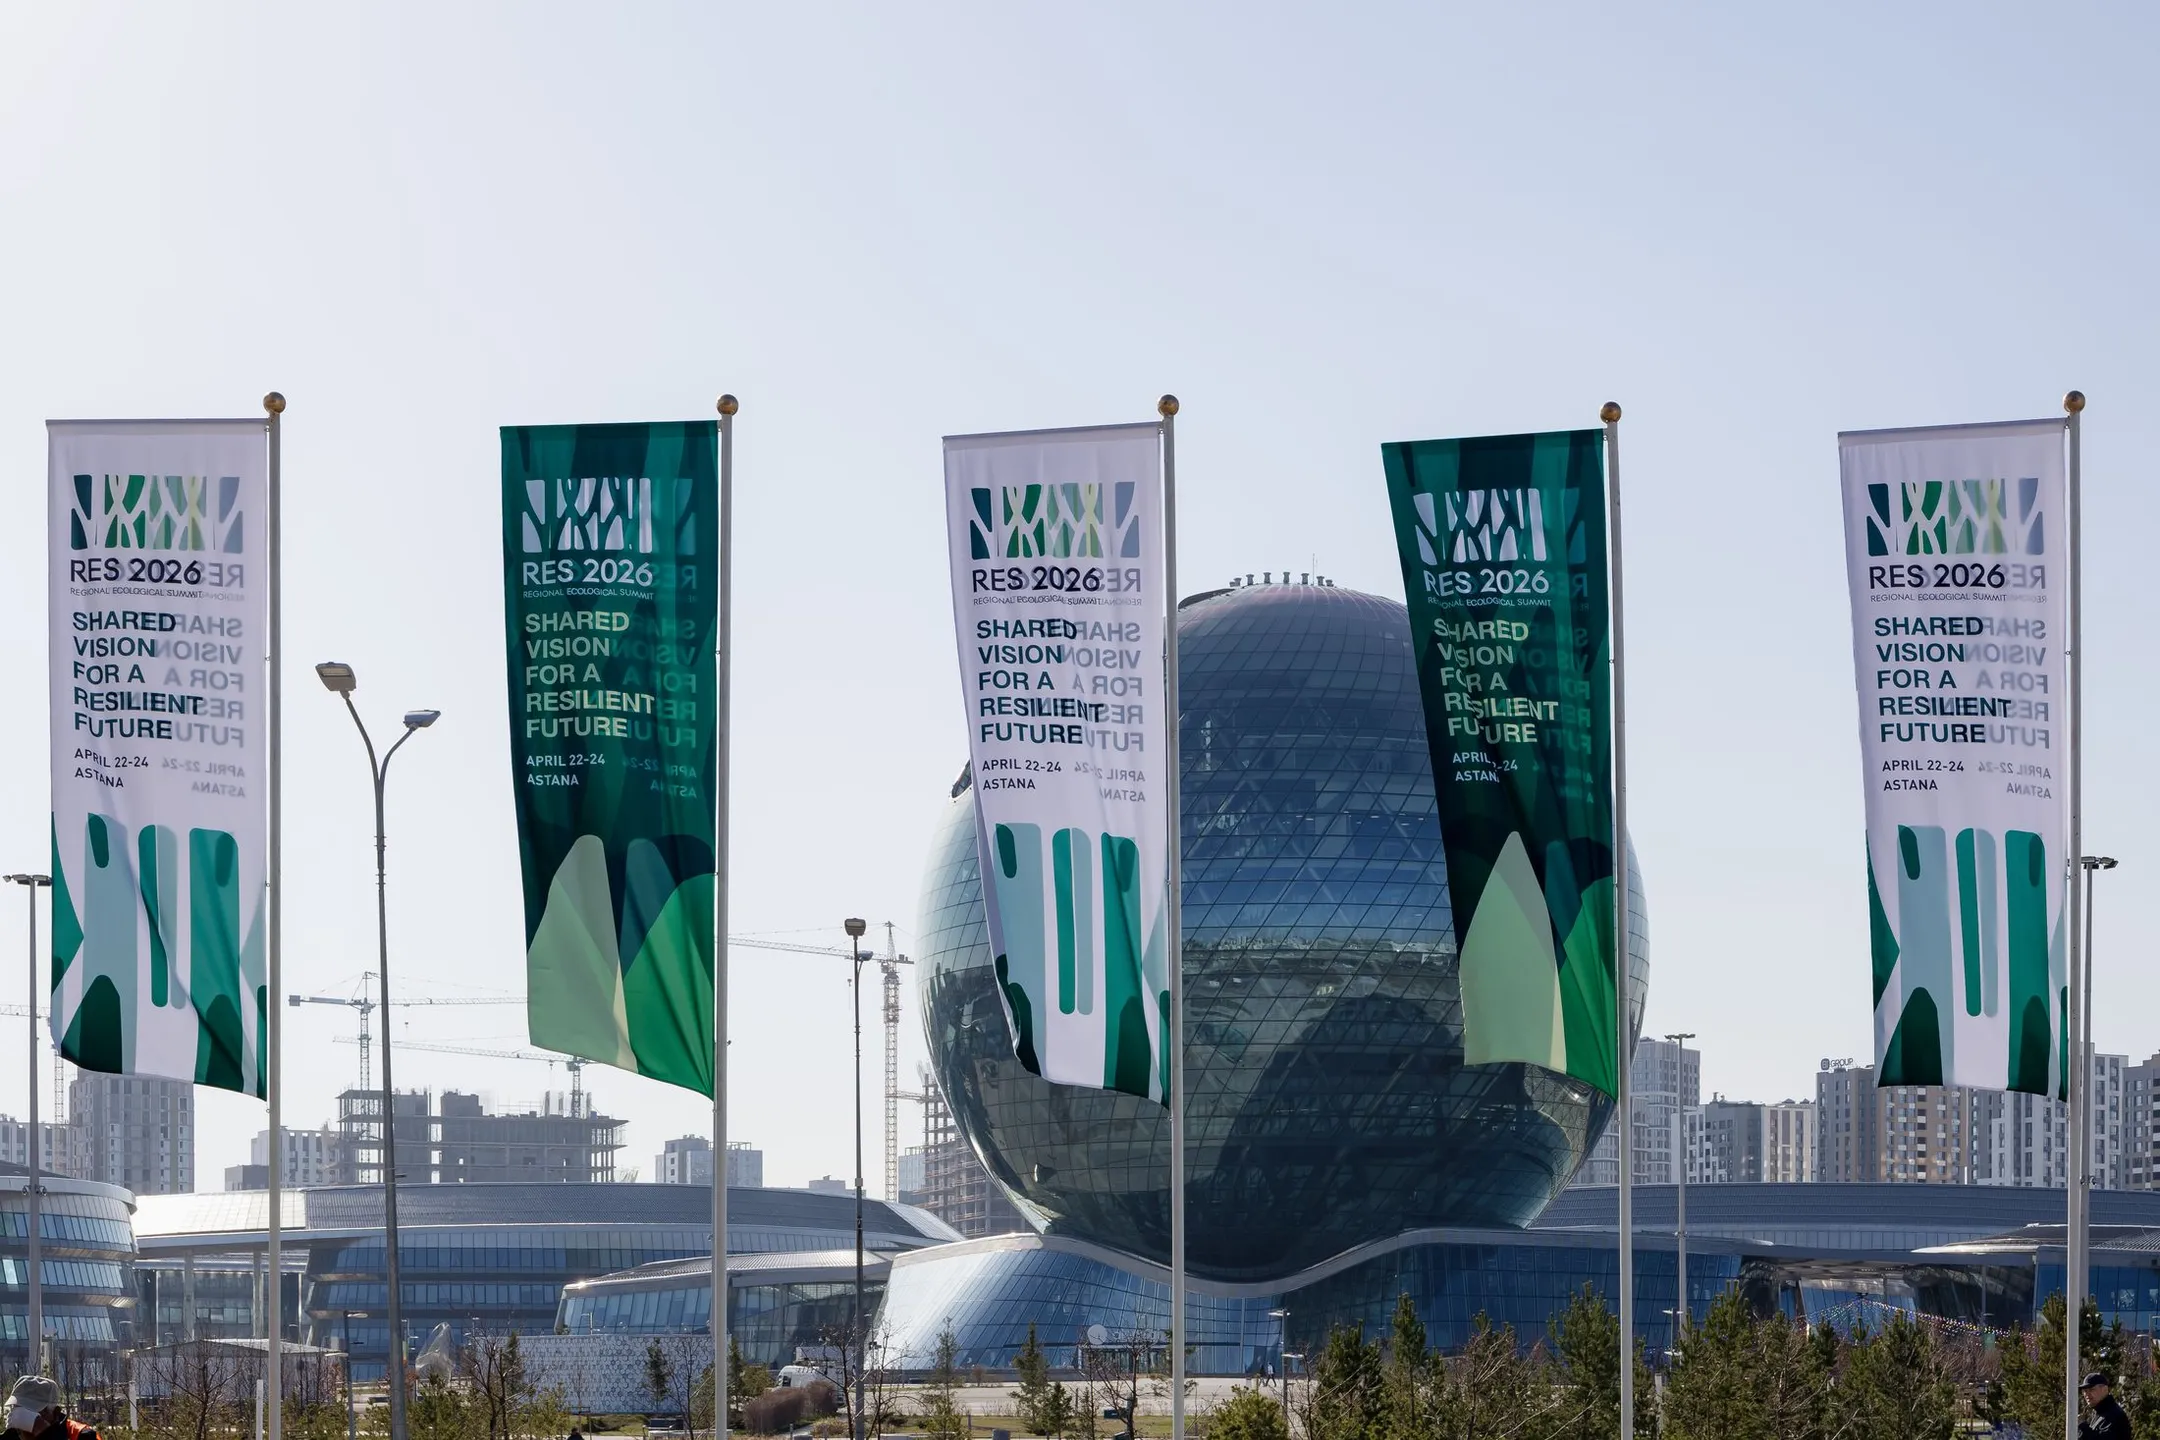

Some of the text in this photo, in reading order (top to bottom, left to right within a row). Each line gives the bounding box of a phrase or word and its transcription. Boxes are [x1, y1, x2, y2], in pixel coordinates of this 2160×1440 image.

[71, 558, 201, 585] RES 2026
[523, 558, 574, 586] RES
[582, 558, 653, 587] 2026
[972, 566, 1100, 593] RES 2026
[1869, 563, 2005, 589] RES 2026
[70, 587, 110, 597] REGIONAL
[112, 587, 164, 597] ECOLOGICAL
[167, 589, 202, 599] SUMMIT
[1423, 570, 1472, 597] RES
[1480, 568, 1549, 595] 2026
[523, 587, 654, 600] REGIONAL ECOLOGICAL SUMMIT
[973, 595, 1101, 606] REGIONAL ECOLOGICAL SUMMIT
[1466, 596, 1515, 607] ECOLOGICAL
[1517, 598, 1552, 607] SUMMIT
[1870, 593, 1915, 602] REGIONAL
[1917, 592, 1970, 602] ECOLOGICAL
[1972, 593, 2007, 602] SUMMIT
[73, 611, 176, 632] SHARED
[525, 611, 630, 633] SHARED
[976, 618, 1077, 639] SHARED
[1433, 618, 1529, 642] SHARED
[1874, 617, 1984, 637] SHARED
[74, 636, 155, 658] VISION
[526, 636, 610, 659] VISION
[978, 644, 1062, 665] VISION
[1876, 643, 1965, 663] VISION
[74, 661, 145, 685] FOR A
[525, 663, 601, 686] FOR A
[979, 670, 1055, 690] FOR A
[1489, 672, 1508, 691] A
[1877, 669, 1957, 689] FOR A
[74, 686, 203, 715] RESILIENT
[526, 689, 655, 714] RESILIENT
[980, 696, 1104, 723] RESILIENT
[1879, 696, 2012, 718] RESILIENT
[75, 712, 172, 740] FUTURE
[526, 716, 628, 738] FUTURE
[981, 722, 1083, 744] FUTURE
[1447, 717, 1538, 744] FUURE
[1880, 723, 1986, 743] FUTURE
[74, 748, 149, 768] APRIL 22-24
[526, 753, 606, 767] APRIL 22-24
[982, 759, 1062, 773] APRIL 22-24
[1452, 752, 1491, 764] APRIL
[1882, 759, 1965, 772] APRIL 22-24
[75, 767, 124, 788] ASTANA
[527, 773, 579, 786] ASTANA
[983, 778, 1036, 790] ASTANA
[1455, 770, 1500, 782] ASTAN
[1883, 779, 1938, 791] ASTANA
[1830, 1058, 1854, 1067] GROUP
